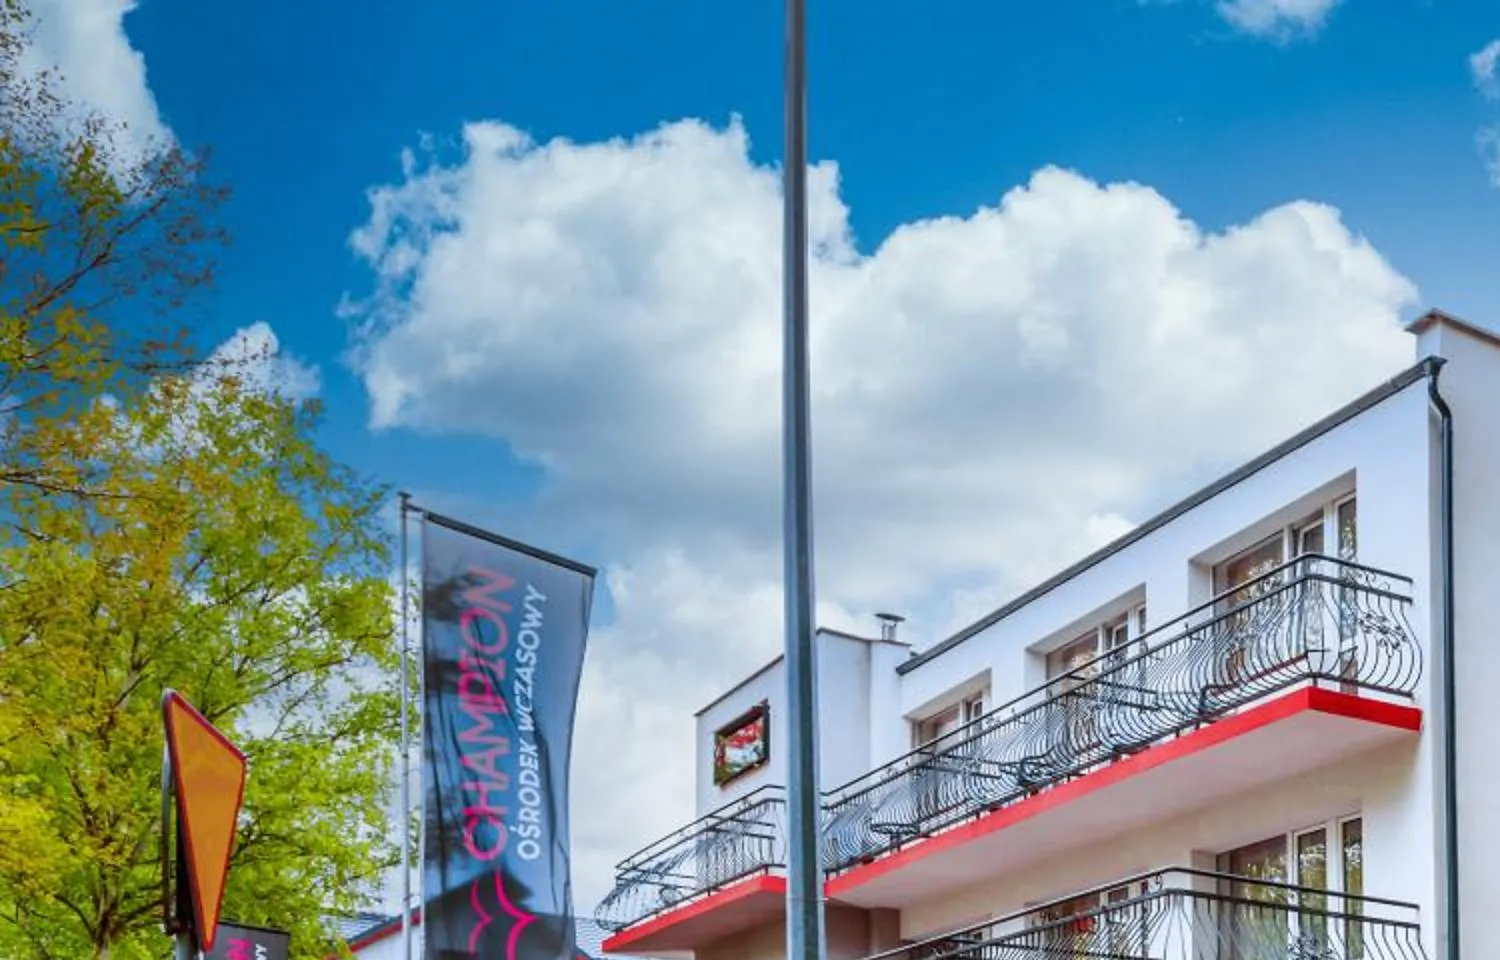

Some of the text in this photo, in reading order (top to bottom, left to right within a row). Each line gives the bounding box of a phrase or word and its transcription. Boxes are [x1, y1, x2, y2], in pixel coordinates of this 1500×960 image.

[457, 565, 516, 861] CHAMPION
[510, 584, 548, 860] OŚRODEK WCZASOWY
